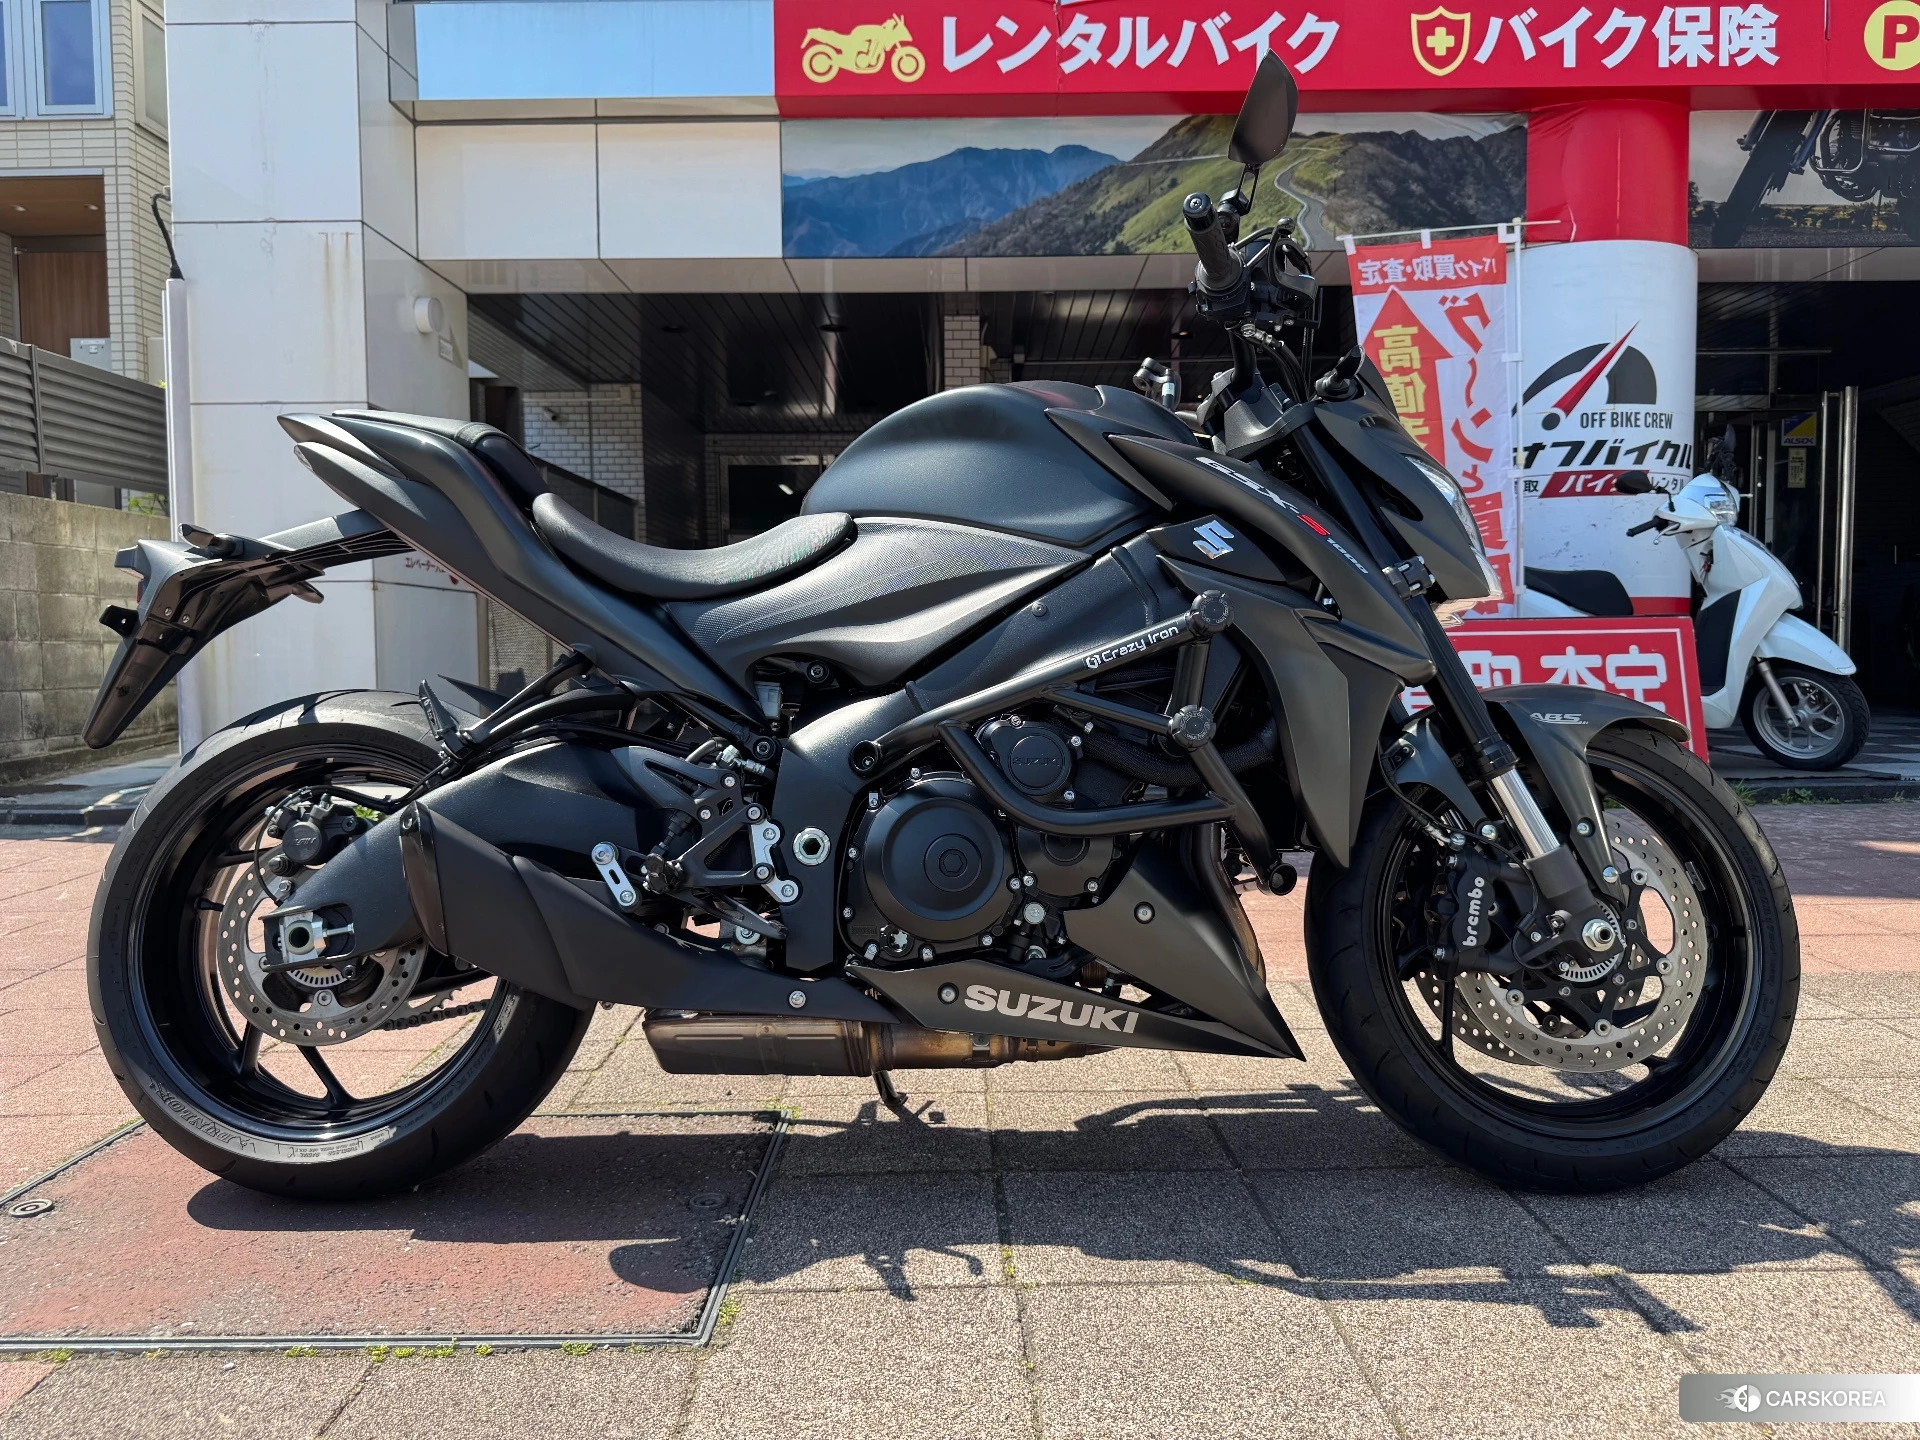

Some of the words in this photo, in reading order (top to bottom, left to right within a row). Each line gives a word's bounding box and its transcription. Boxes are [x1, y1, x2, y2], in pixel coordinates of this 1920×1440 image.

[942, 12, 1340, 75] レンタルバイク
[1473, 4, 1780, 69] バイク保険
[1580, 411, 1606, 429] OFF
[1610, 411, 1641, 428] BIKE
[1645, 412, 1673, 430] CREW
[1559, 473, 1618, 493] バイ
[1101, 640, 1147, 663] Crazy
[1149, 625, 1180, 644] Iron
[1529, 712, 1588, 724] ABS
[1462, 876, 1485, 947] brembo
[964, 984, 1140, 1034] SUZUKI
